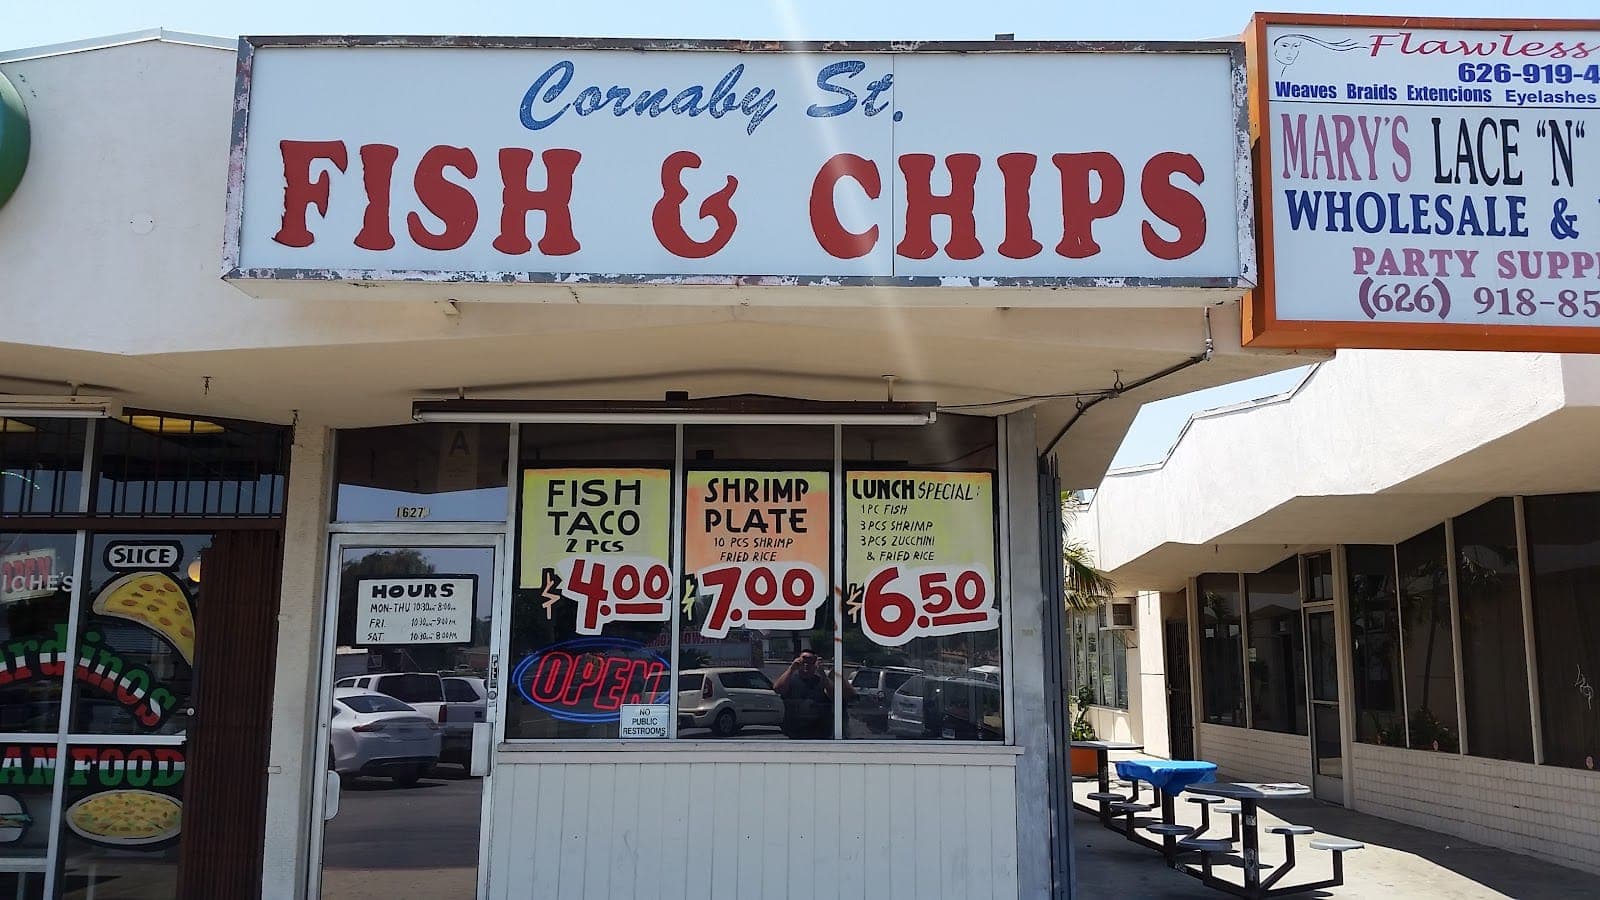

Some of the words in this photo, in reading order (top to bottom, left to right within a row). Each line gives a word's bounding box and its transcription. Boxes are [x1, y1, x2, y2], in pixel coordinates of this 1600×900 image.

[1369, 32, 1600, 59] Flawless
[1458, 62, 1600, 85] 626-919-4
[519, 60, 777, 136] Cornaby
[807, 60, 903, 122] St.
[1275, 81, 1337, 99] Weaves
[1346, 83, 1397, 101] Braids
[1407, 85, 1492, 103] Extencions
[1505, 89, 1597, 106] Eyelashes
[1280, 113, 1412, 182] MARY'S
[1431, 117, 1523, 187] LACE
[271, 139, 582, 256] FISH
[652, 150, 738, 259] &
[809, 151, 1207, 260] CHIPS
[1285, 189, 1529, 237] WHOLESALE
[1550, 197, 1579, 240] &
[1352, 246, 1479, 278] PARTY
[1497, 250, 1600, 279] SUPP
[1358, 277, 1451, 320] (626)
[1473, 286, 1600, 318] 918-85
[547, 479, 641, 507] FISH
[704, 477, 809, 503] SHRIMP
[852, 479, 915, 500] LUNCH
[396, 506, 425, 518] 1627
[705, 508, 808, 534] PLATE
[884, 505, 908, 515] FISH
[547, 510, 640, 536] TACO
[891, 521, 933, 532] SHRIMP
[565, 538, 577, 553] 2
[585, 539, 624, 553] PCS
[714, 537, 726, 548] 10
[731, 537, 749, 548] PCS
[753, 537, 793, 549] SHRIMP
[891, 535, 935, 546] ZUCCHINI
[113, 546, 171, 564] SLICE
[720, 551, 749, 563] FRIED
[752, 551, 777, 562] RICE
[866, 551, 875, 561] &
[879, 551, 910, 562] FRIED
[913, 551, 935, 561] RICE
[371, 583, 455, 598] HOURS
[370, 602, 410, 613] MON-THU
[531, 651, 664, 711] OPEN
[631, 718, 658, 726] PUBLIC
[639, 708, 651, 716] NO
[622, 727, 667, 735] RESTROOMS
[69, 747, 186, 787] FOOD
